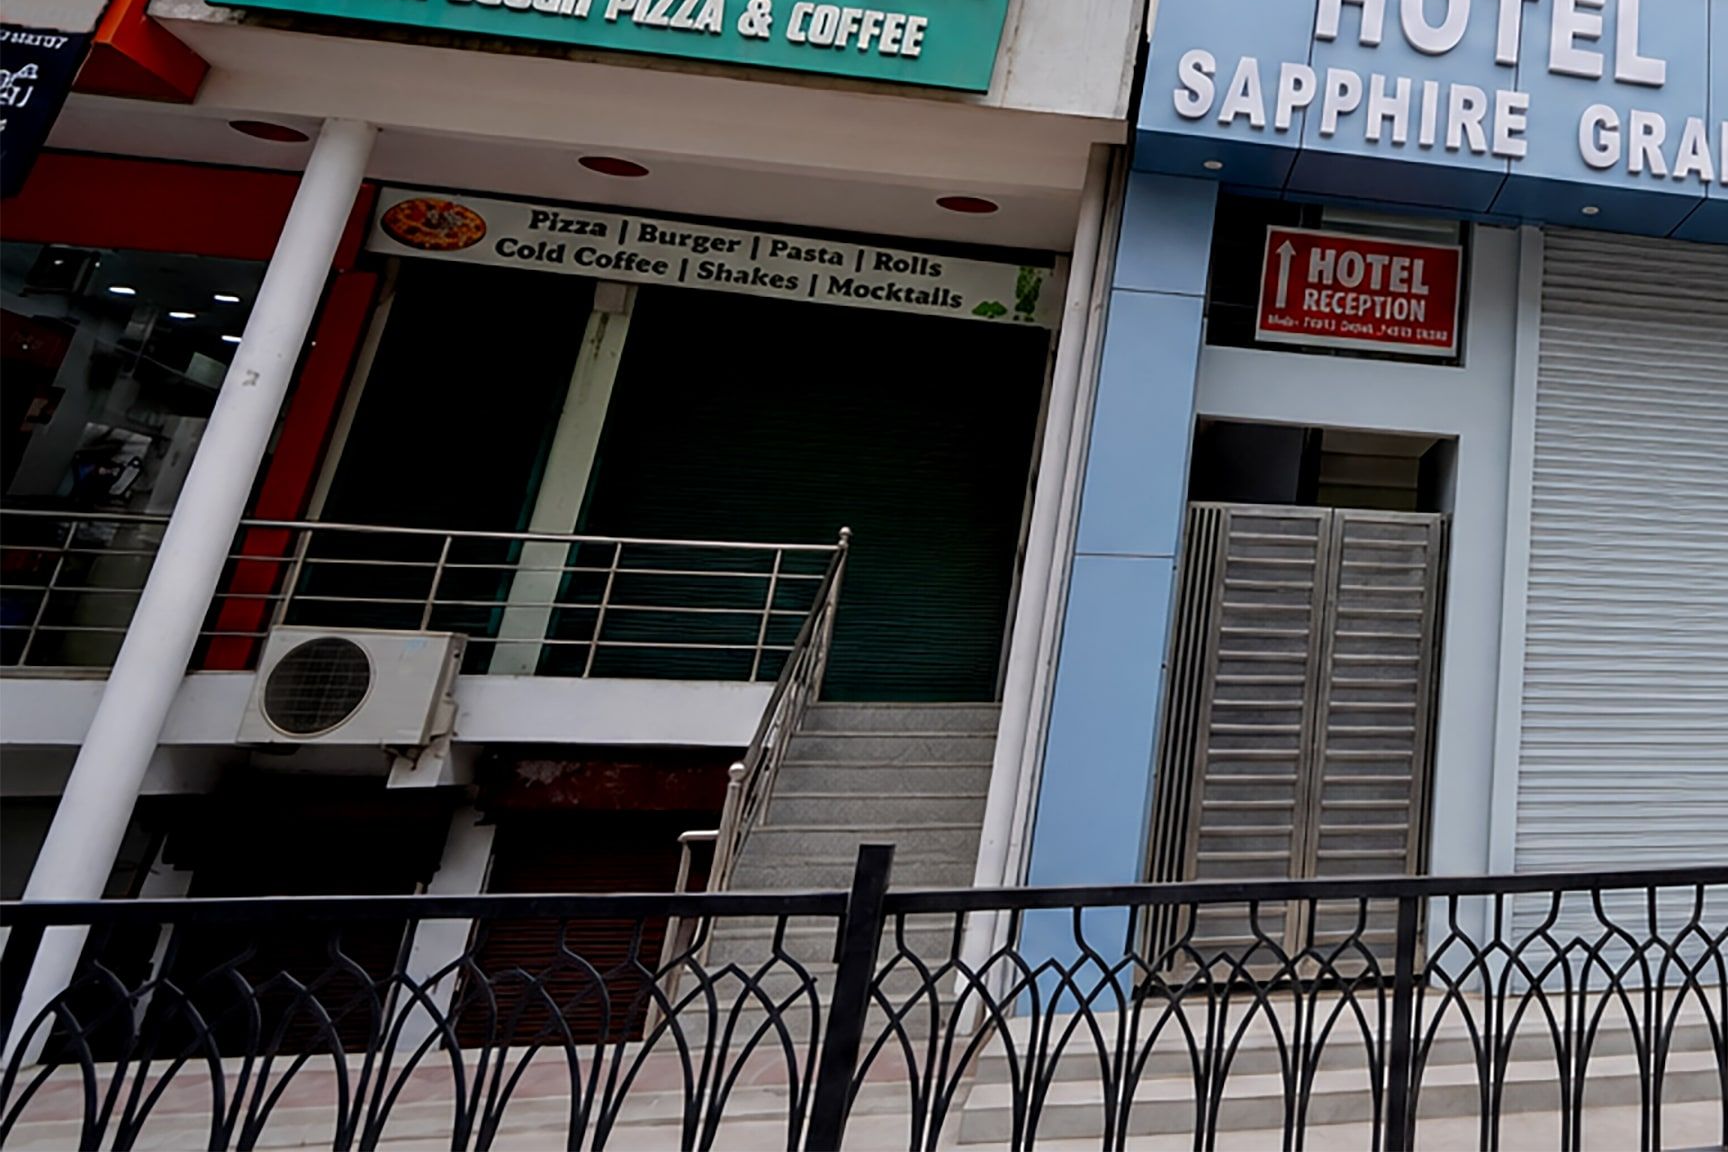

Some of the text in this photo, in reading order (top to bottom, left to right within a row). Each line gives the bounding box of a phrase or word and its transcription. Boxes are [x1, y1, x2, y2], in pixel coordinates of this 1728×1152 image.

[786, 1, 928, 57] COFFEE
[1172, 49, 1530, 158] SAPPHIRE
[495, 237, 963, 309] Cold Coffee Shakes Mocktails
[528, 209, 943, 278] Pizza Burger Pasta Rolls
[1307, 247, 1429, 295] HOTEL
[1303, 288, 1425, 322] RECEPTION
